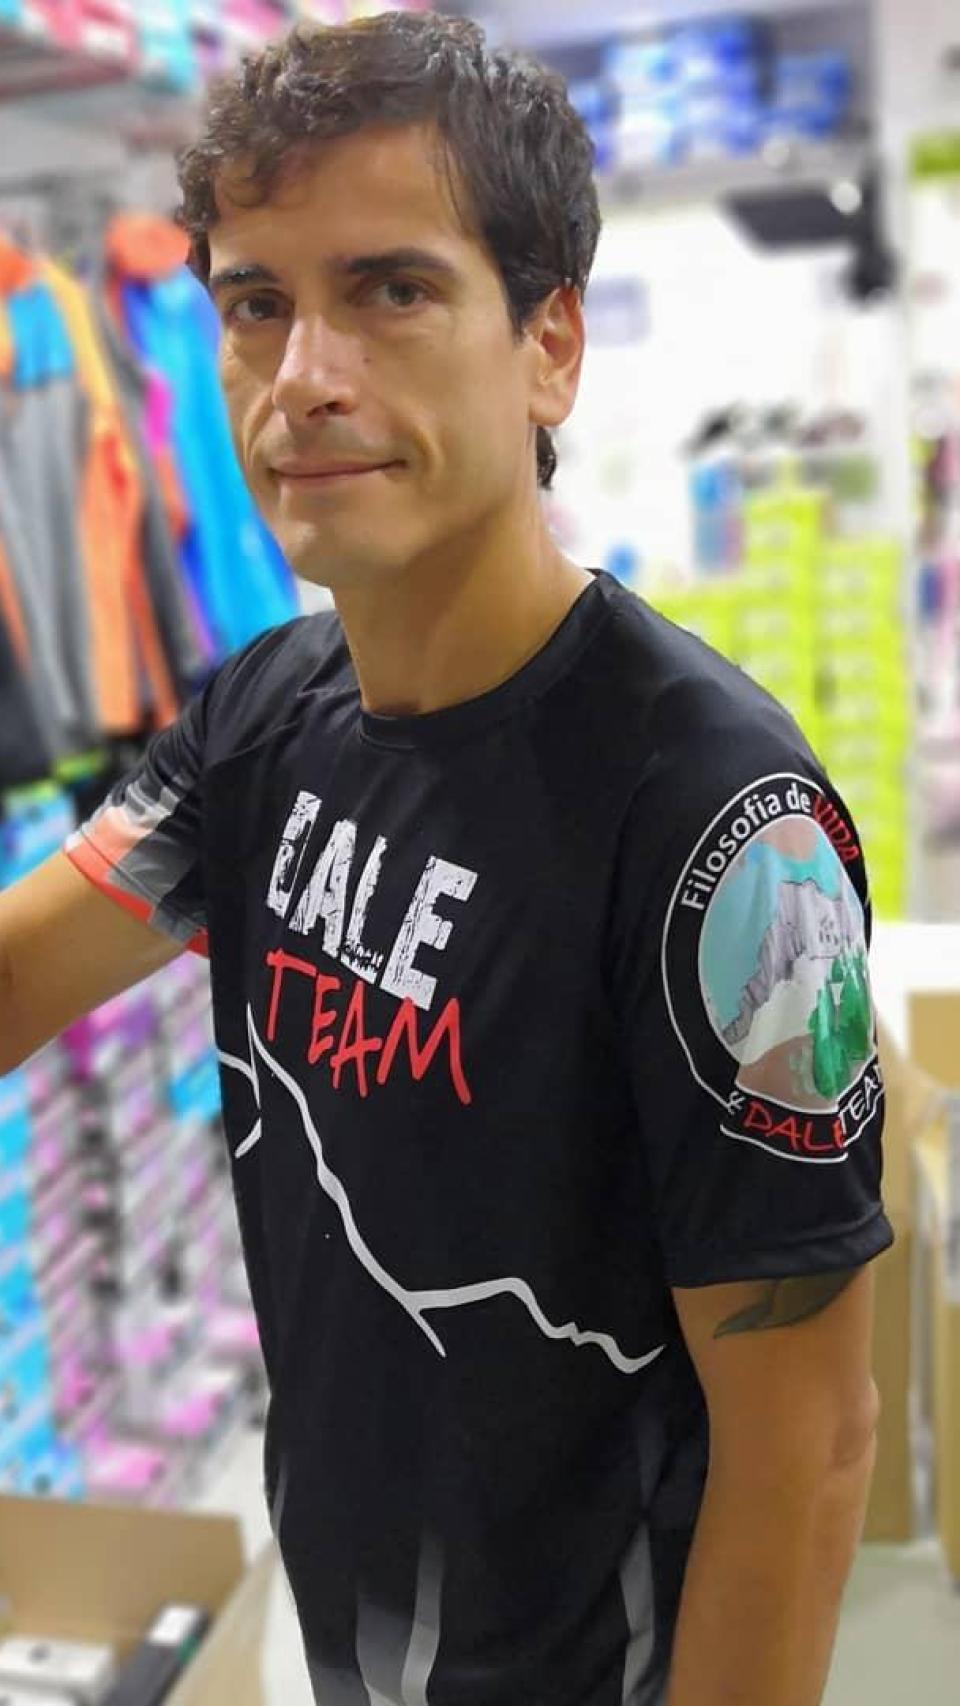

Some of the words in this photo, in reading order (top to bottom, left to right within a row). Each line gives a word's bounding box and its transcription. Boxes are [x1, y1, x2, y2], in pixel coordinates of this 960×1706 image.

[266, 790, 478, 1011] DALE
[681, 790, 782, 911] Filosofia
[786, 782, 811, 813] de
[813, 794, 860, 861] VIDA
[266, 948, 472, 1105] TEAM
